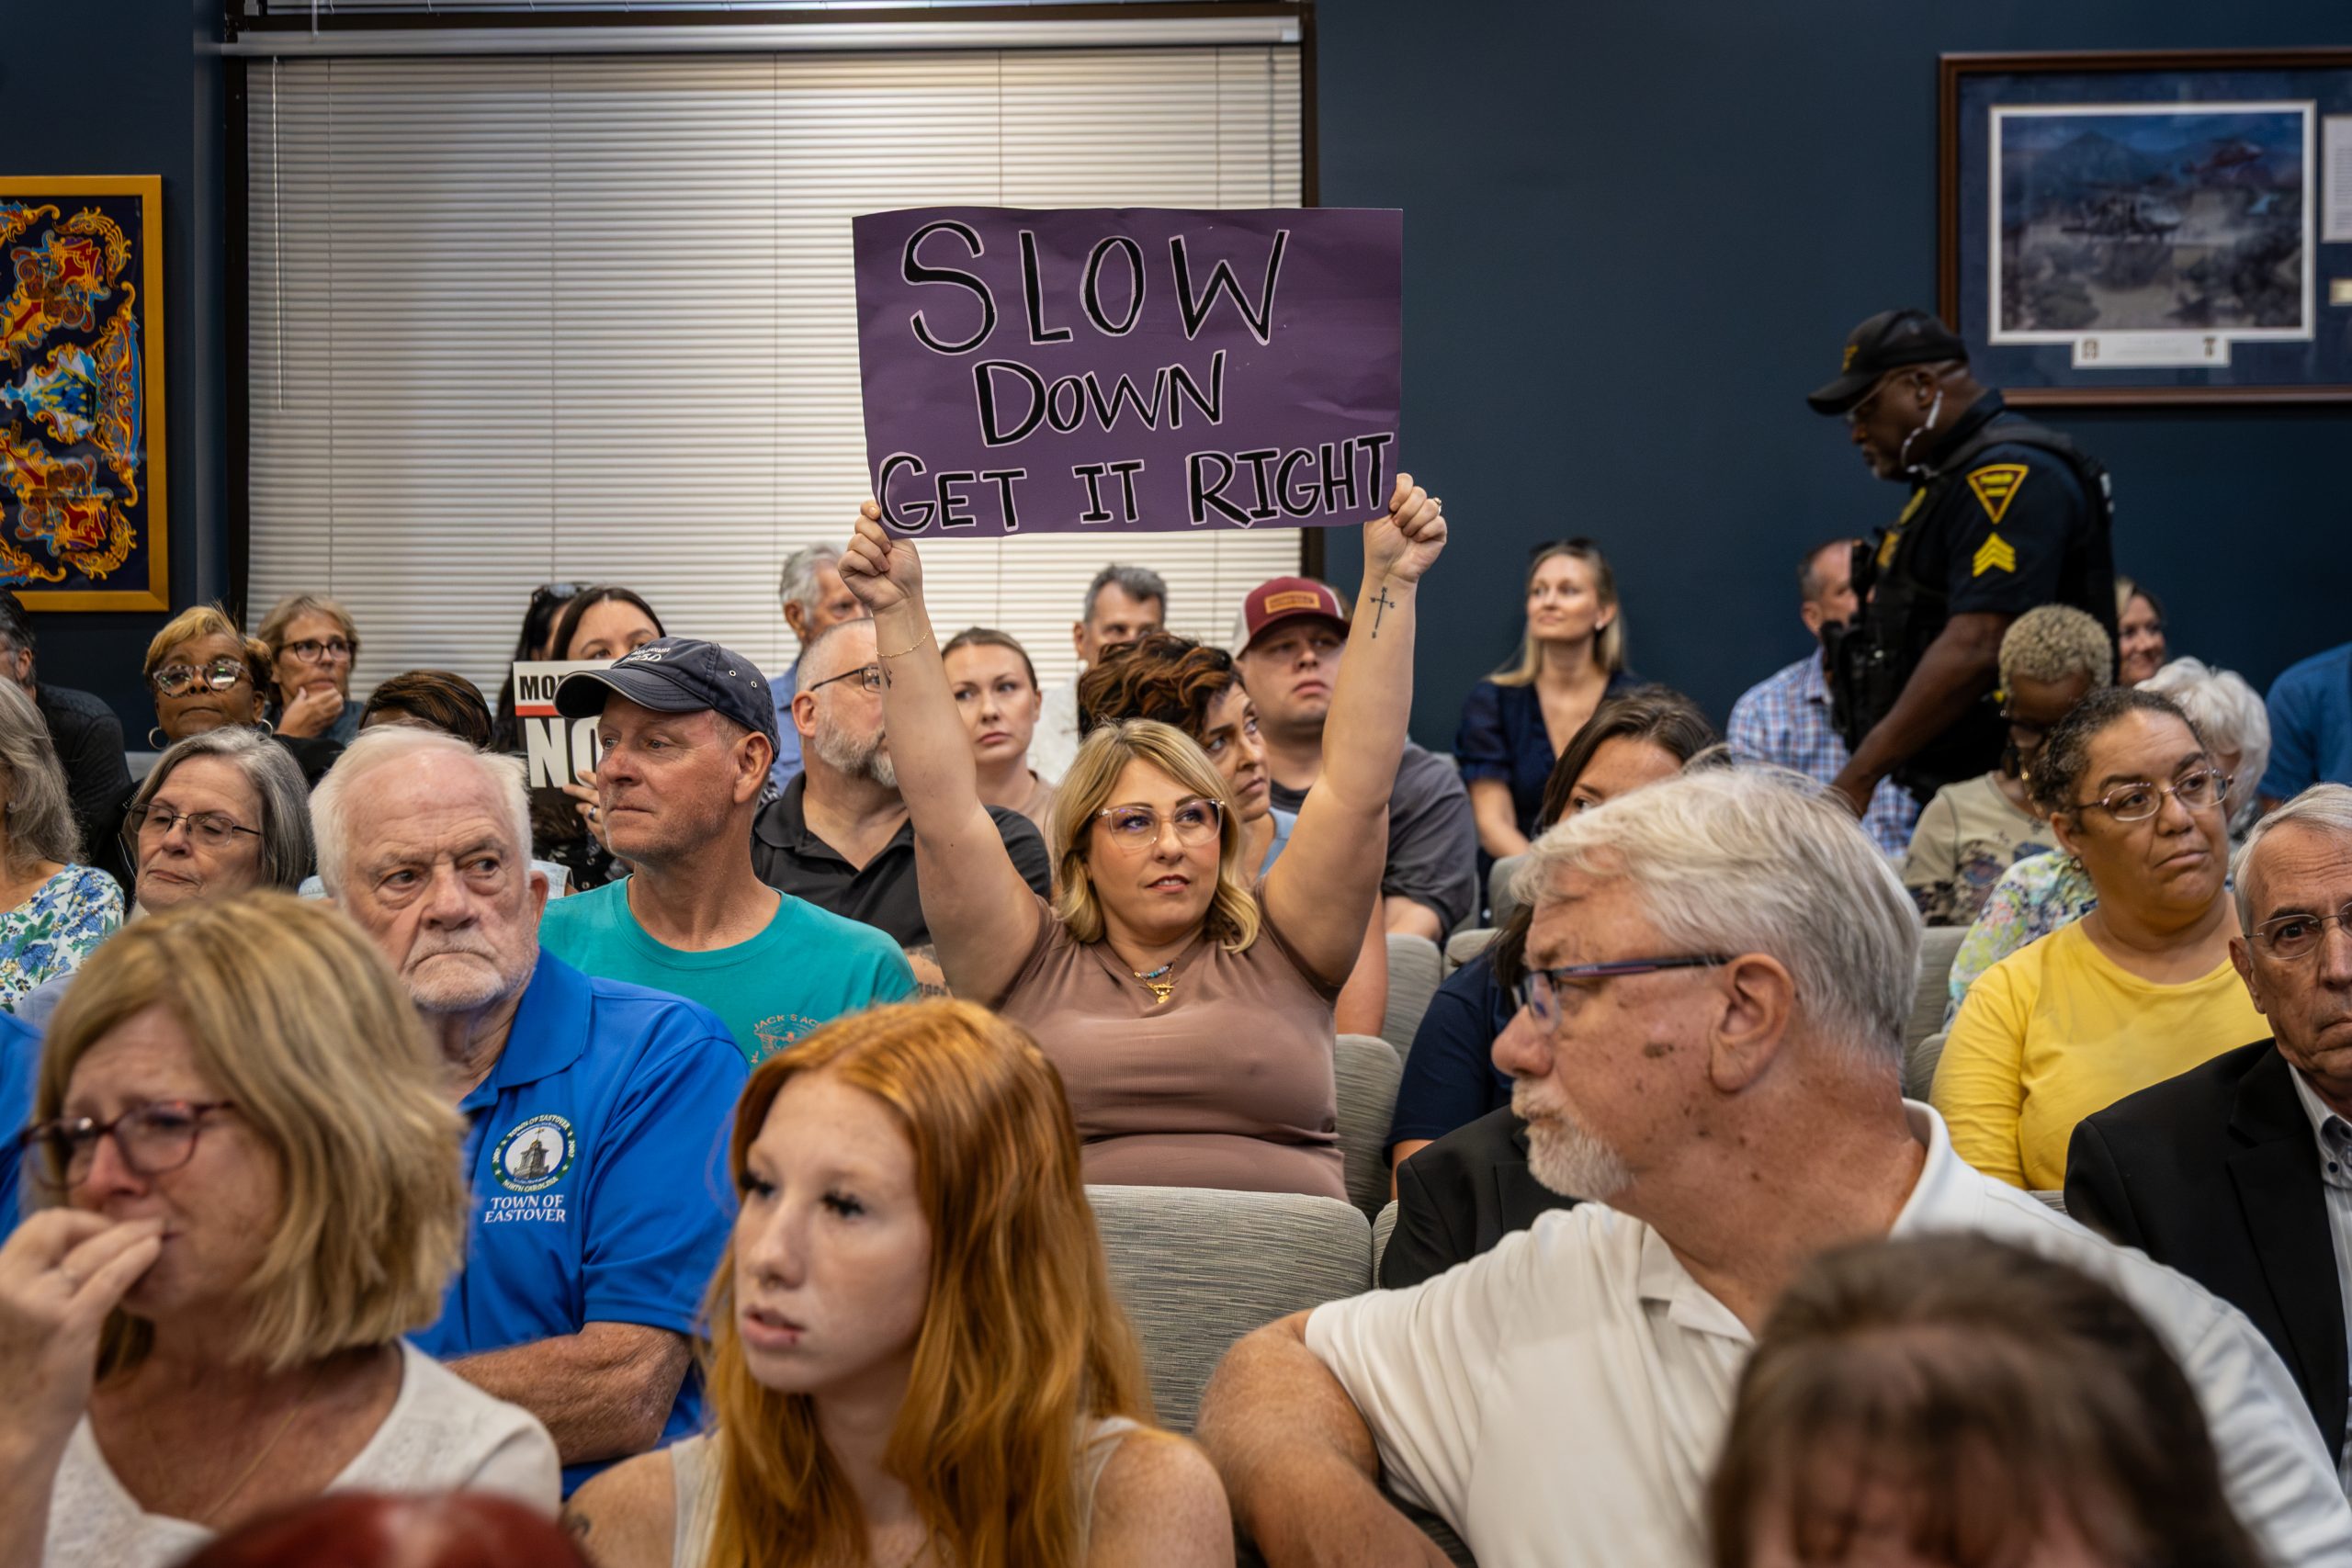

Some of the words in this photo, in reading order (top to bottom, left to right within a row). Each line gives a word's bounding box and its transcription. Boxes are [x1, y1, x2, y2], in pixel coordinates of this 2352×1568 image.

[901, 220, 1290, 355] SLOW
[972, 349, 1227, 447] DOWN
[876, 452, 1027, 535] GET
[1071, 459, 1144, 525] IT
[1185, 433, 1394, 529] RIGHT
[519, 675, 566, 700] MO
[528, 1115, 540, 1126] OF
[538, 1114, 571, 1129] EASTOVER
[502, 1179, 525, 1192] NORTH
[524, 1176, 560, 1192] CAROLINA
[491, 1195, 539, 1210] TOWN
[542, 1194, 564, 1208] OF
[483, 1209, 567, 1224] EASTOVER
